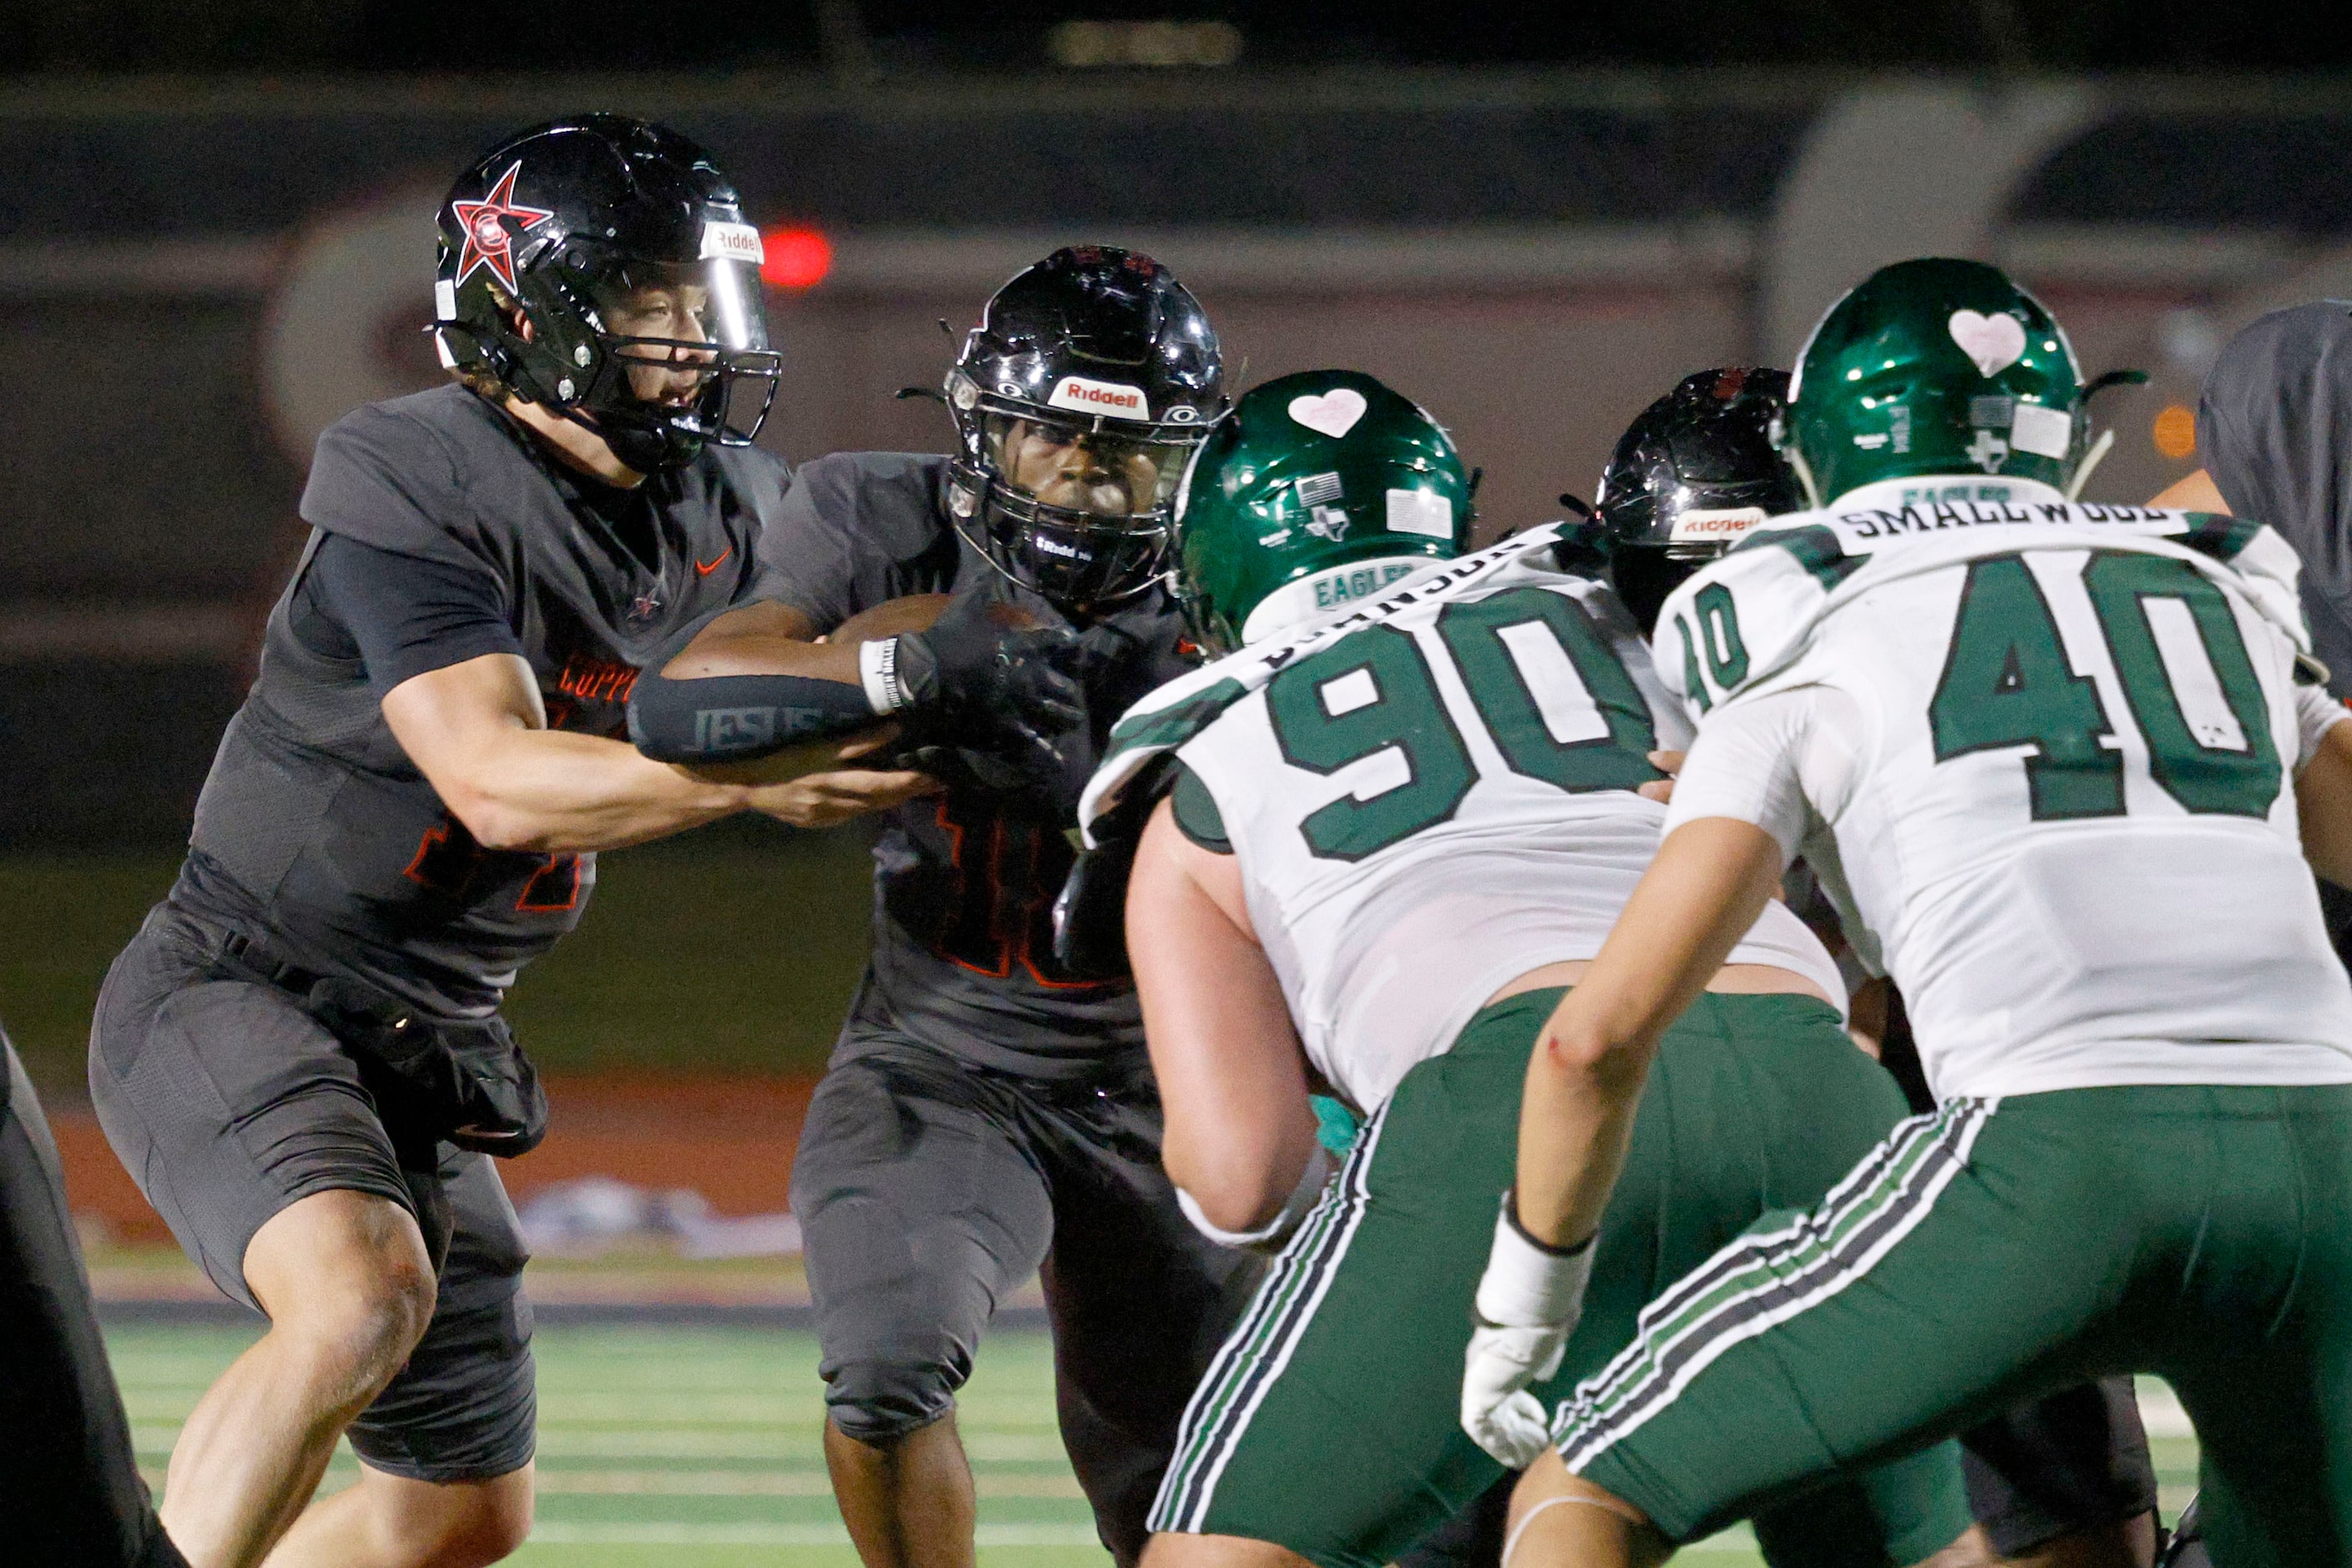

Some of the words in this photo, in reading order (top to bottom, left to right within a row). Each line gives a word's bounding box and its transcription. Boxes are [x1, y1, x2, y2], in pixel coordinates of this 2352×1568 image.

[1068, 383, 1138, 407] Riddell
[1264, 587, 1669, 863] 90
[1927, 548, 2283, 822] 40
